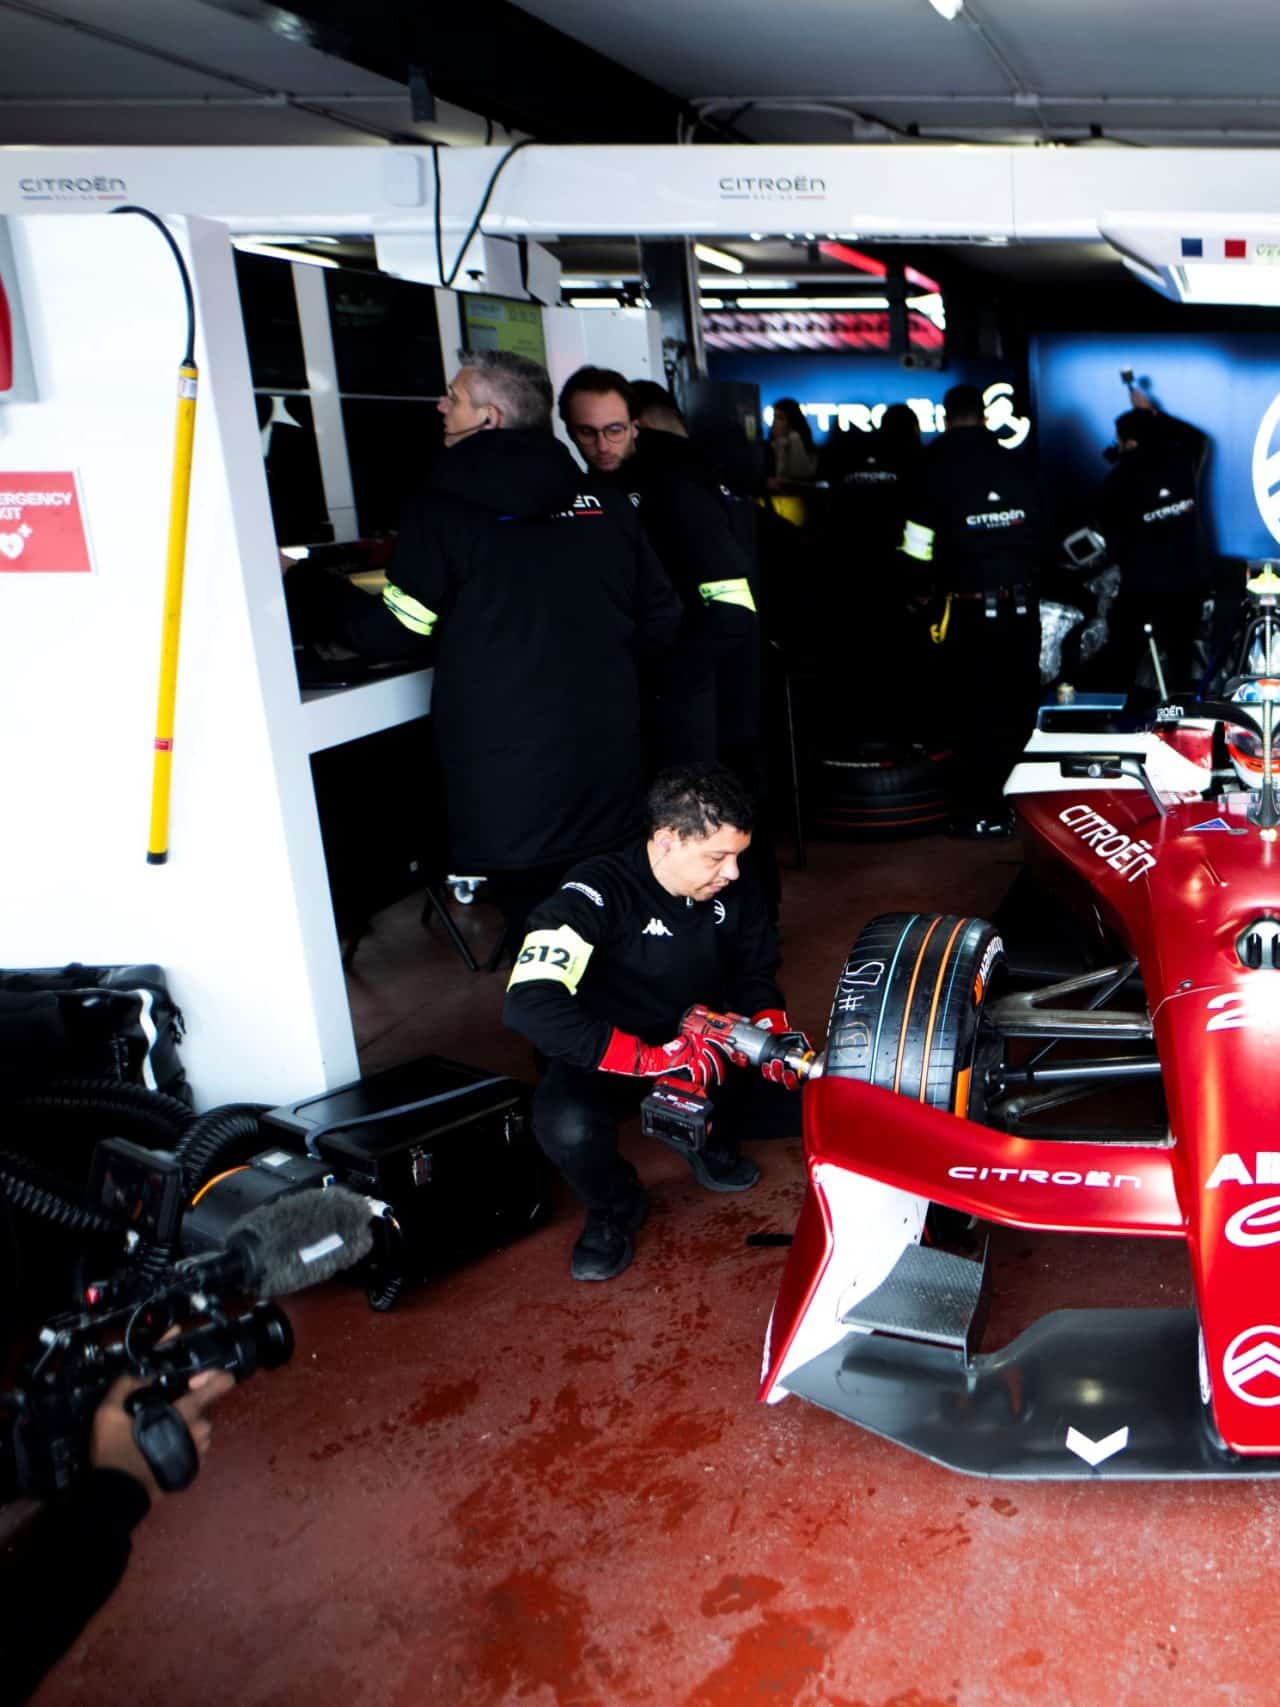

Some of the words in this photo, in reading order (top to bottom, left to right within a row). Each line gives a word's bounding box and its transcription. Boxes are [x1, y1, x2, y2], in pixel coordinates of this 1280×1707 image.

[719, 175, 826, 191] CITROËN
[1058, 804, 1157, 882] CITROËN
[948, 1166, 1142, 1189] CITROËN
